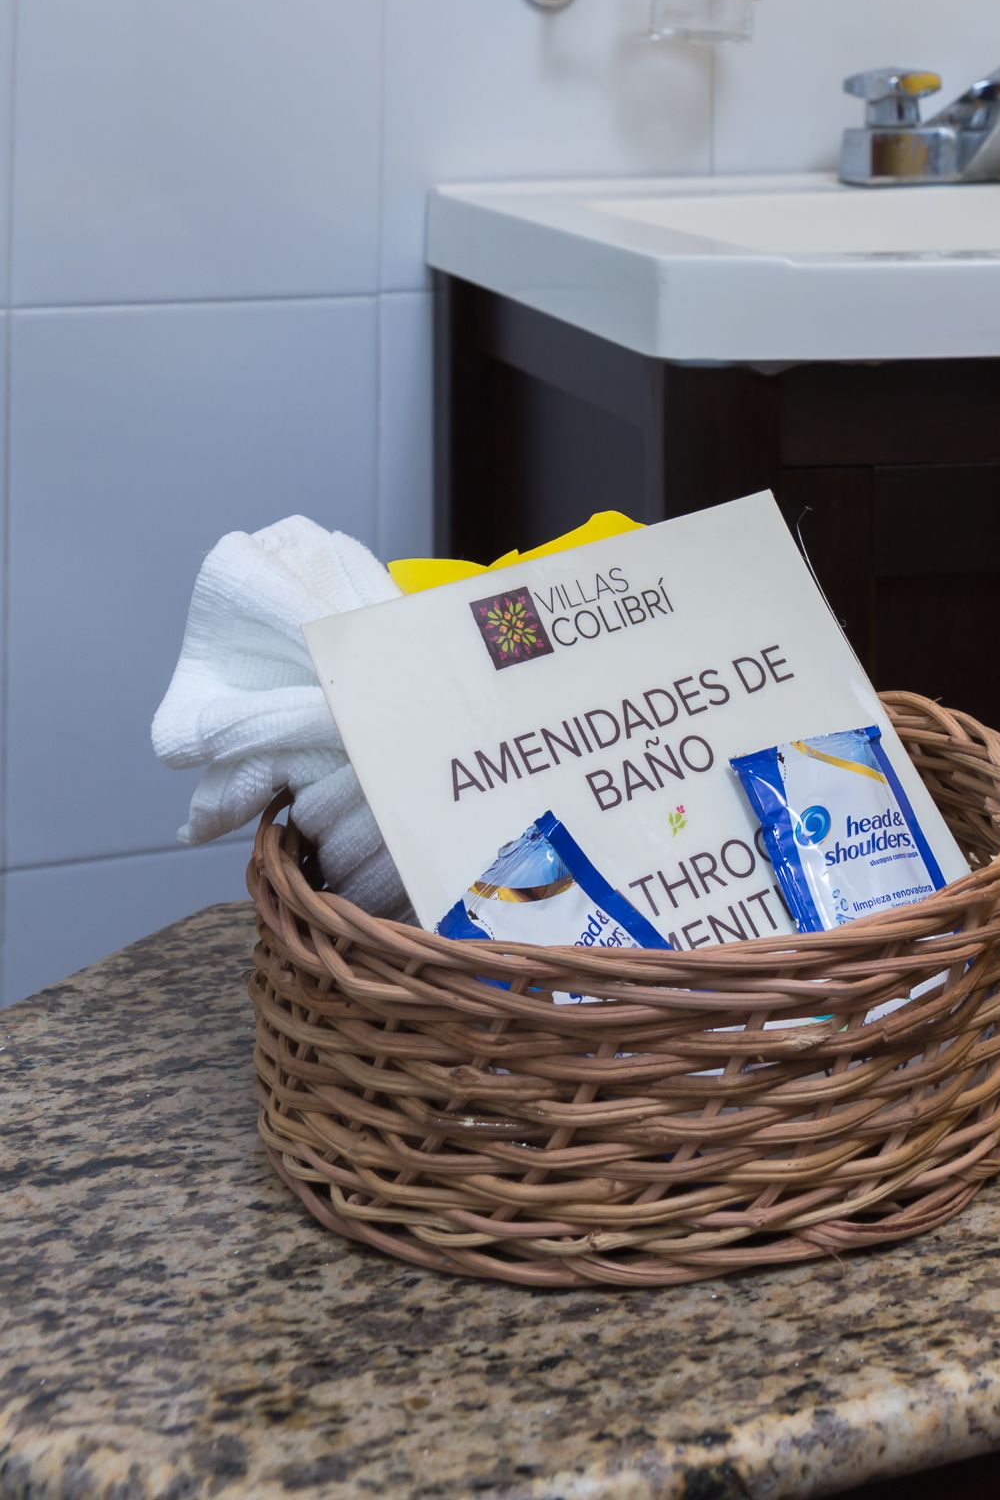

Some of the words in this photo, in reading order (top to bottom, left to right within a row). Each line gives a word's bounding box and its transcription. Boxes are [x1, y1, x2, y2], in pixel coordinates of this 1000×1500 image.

[533, 567, 629, 614] VILLAS
[551, 577, 674, 646] COLIBRÍ
[450, 669, 730, 802] AMENIDADES
[731, 644, 795, 694] DE
[585, 734, 714, 811] BAÑO
[824, 830, 911, 866] shoulders
[852, 894, 892, 912] limpieza
[892, 884, 933, 900] renovadora
